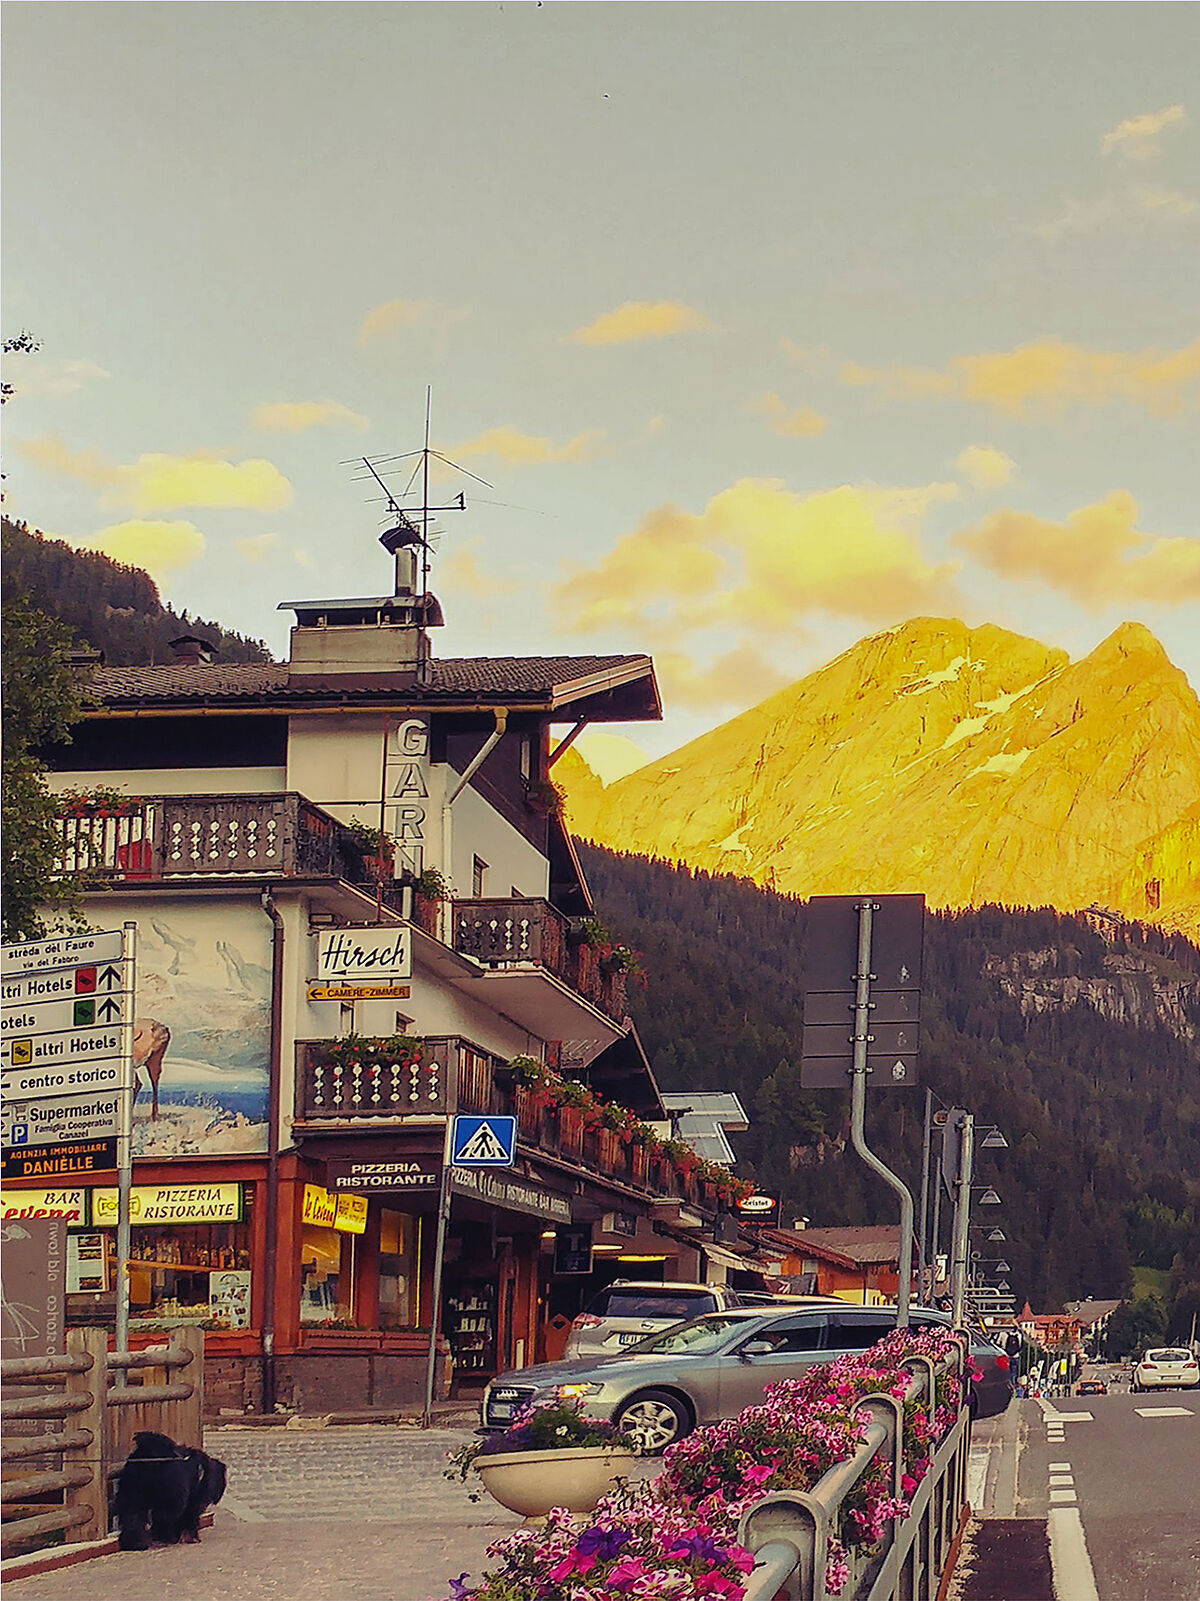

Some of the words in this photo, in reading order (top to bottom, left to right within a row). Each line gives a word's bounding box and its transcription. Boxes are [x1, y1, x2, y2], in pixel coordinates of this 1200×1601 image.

[393, 719, 429, 920] GARNI
[65, 940, 95, 951] Faure
[321, 933, 405, 969] Hirsch
[37, 958, 50, 966] del
[52, 956, 80, 965] Fabbro
[1, 984, 21, 999] ltri
[28, 977, 73, 995] Hotels
[1, 1013, 36, 1030] otels
[35, 1041, 64, 1057] altri
[70, 1035, 117, 1053] Hotels
[20, 1074, 64, 1089] centro
[68, 1068, 116, 1084] storico
[30, 1099, 119, 1123] Supermarket
[35, 1124, 66, 1133] Famiglia
[67, 1118, 113, 1131] Cooperativa
[10, 1149, 47, 1160] AGENZIA
[50, 1142, 108, 1155] IMMOBILIARE
[23, 1155, 94, 1175] DANIÈLLE
[351, 1162, 421, 1174] PIZZERIA
[336, 1174, 436, 1187] RISTORANTE
[44, 1192, 80, 1205] BAR
[156, 1188, 221, 1202] PIZZERIA
[4, 1205, 80, 1222] evena
[101, 1201, 137, 1211] FOT
[144, 1203, 235, 1218] RISTORANTE
